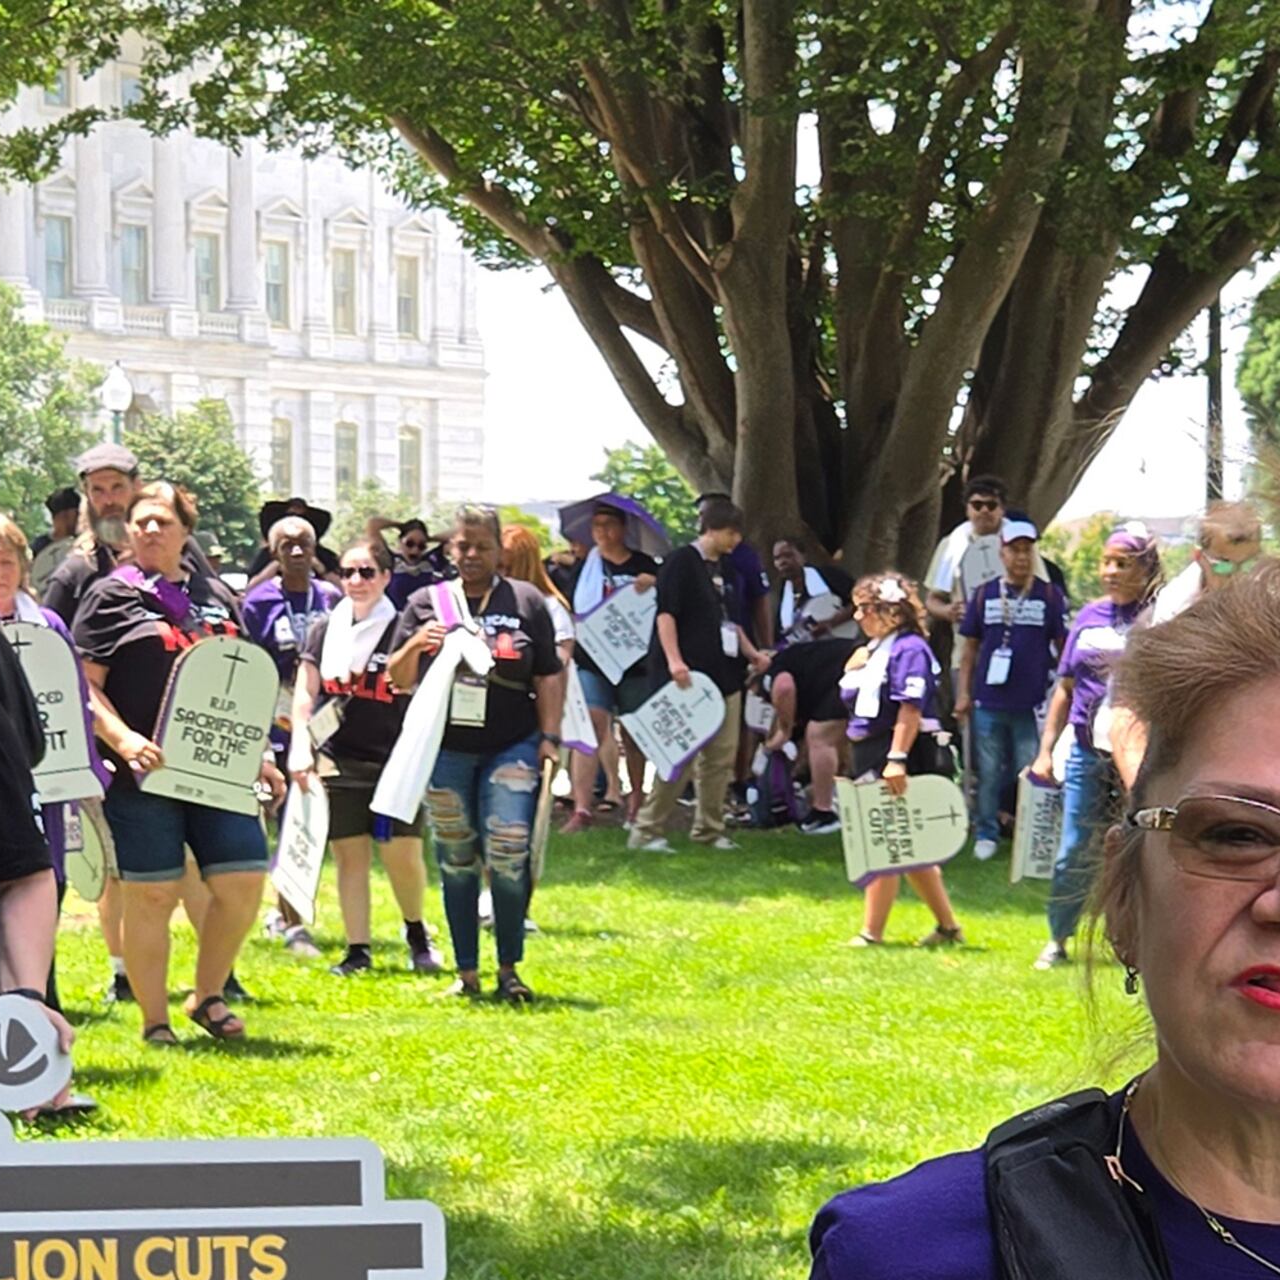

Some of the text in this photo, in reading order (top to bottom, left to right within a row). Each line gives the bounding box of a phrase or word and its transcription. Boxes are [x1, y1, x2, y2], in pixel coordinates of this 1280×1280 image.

[173, 708, 264, 742] SACRIFICED
[181, 726, 249, 755] FOR THE
[192, 746, 230, 769] RICH
[868, 808, 884, 847] CUTS
[880, 800, 900, 864] TRILLION
[896, 797, 910, 836] EATH
